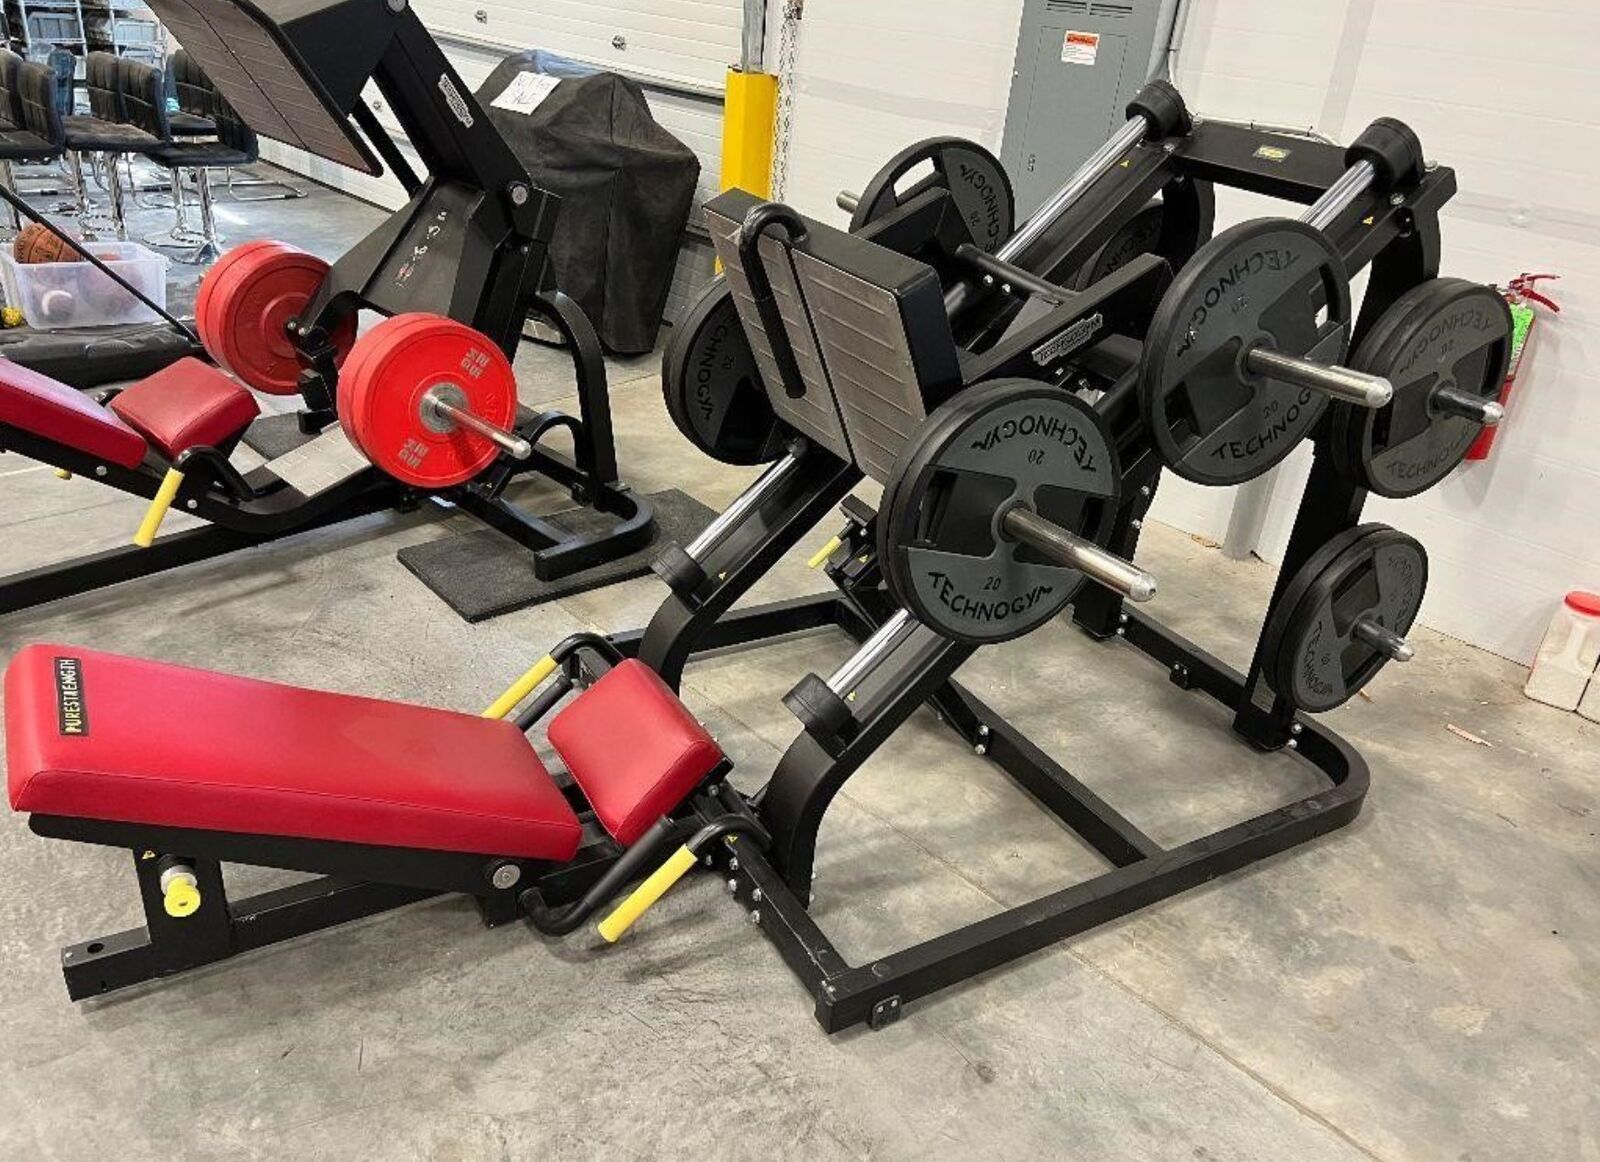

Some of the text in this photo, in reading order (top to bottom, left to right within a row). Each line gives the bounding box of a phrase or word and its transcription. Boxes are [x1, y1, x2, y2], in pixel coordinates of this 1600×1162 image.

[960, 163, 999, 253] ECHNOGYM
[971, 414, 1097, 473] TECHNOGYM
[1210, 385, 1312, 459] TECHNOG
[1027, 449, 1046, 466] 20
[927, 571, 1054, 622] TECHNOGYM
[983, 576, 1002, 592] 20
[59, 659, 82, 734] PURESTRENGTH
